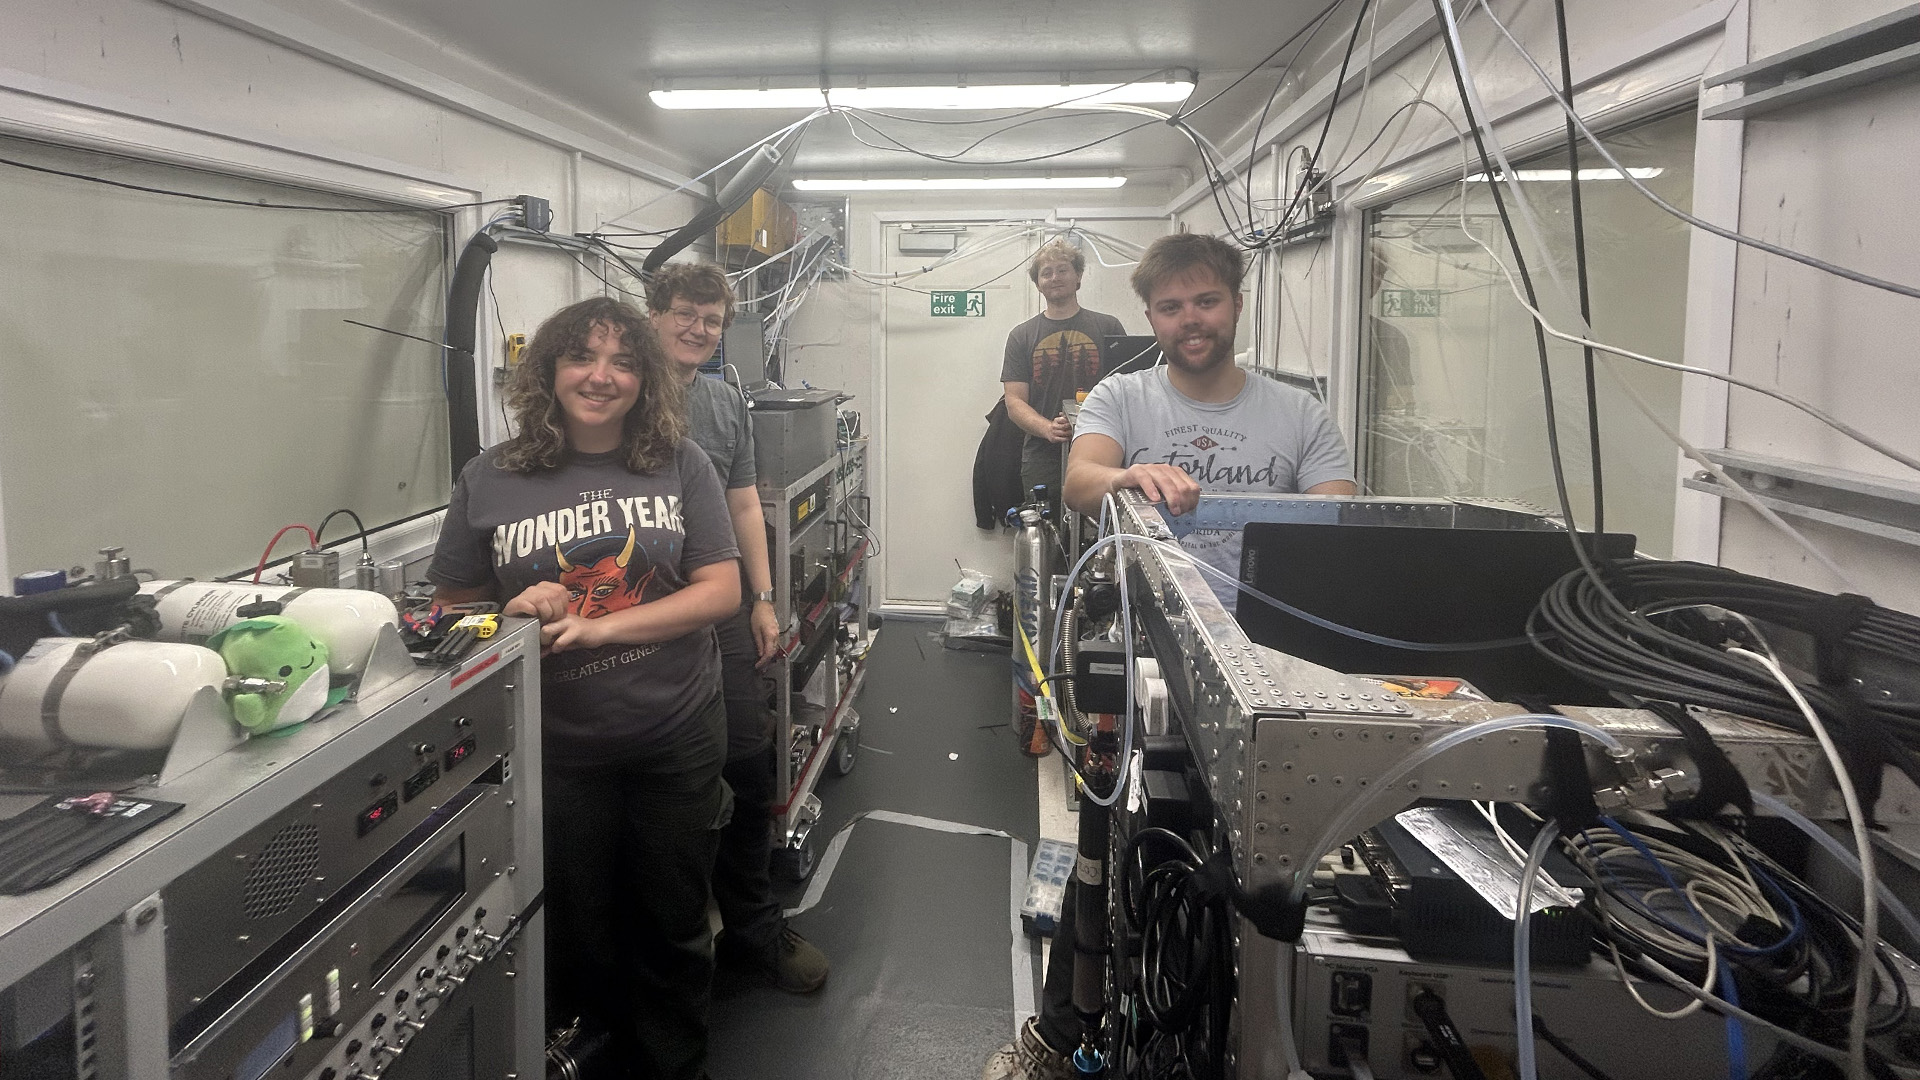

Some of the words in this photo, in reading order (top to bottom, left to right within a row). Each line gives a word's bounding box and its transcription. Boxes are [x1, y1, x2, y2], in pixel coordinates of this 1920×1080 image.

[933, 294, 955, 303] Fire
[933, 304, 955, 314] exit
[1164, 424, 1199, 438] FINEST
[1201, 425, 1248, 442] QUALITY
[1196, 437, 1213, 448] USA
[1130, 447, 1278, 487] torland
[579, 488, 614, 502] THE
[493, 500, 612, 567] WONDER
[1244, 549, 1256, 584] Lenovo
[554, 655, 617, 681] GREATEST
